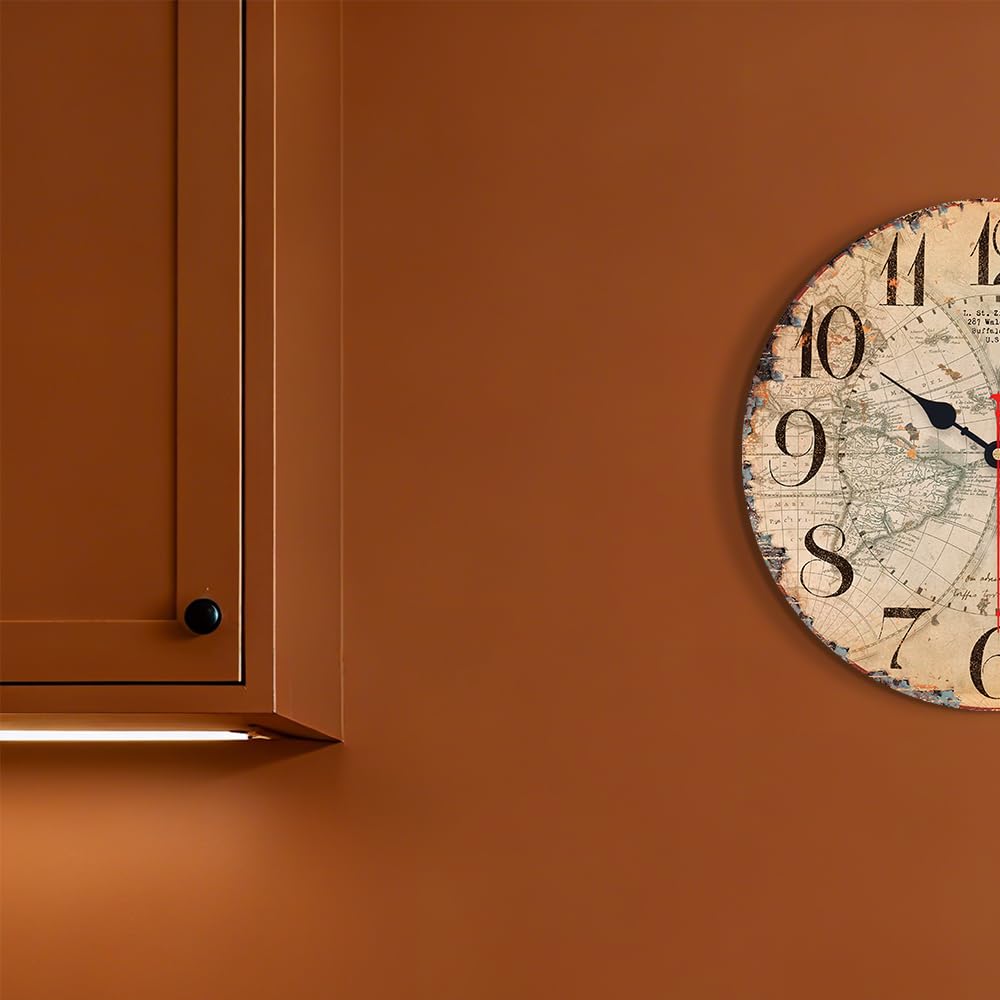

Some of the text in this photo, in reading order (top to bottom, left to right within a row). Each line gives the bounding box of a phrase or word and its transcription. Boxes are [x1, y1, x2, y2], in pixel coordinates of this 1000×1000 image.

[879, 232, 926, 306] 11
[793, 305, 866, 380] 10
[976, 309, 990, 317] St.
[769, 409, 826, 487] 9
[799, 523, 854, 598] 8
[878, 607, 931, 669] 7
